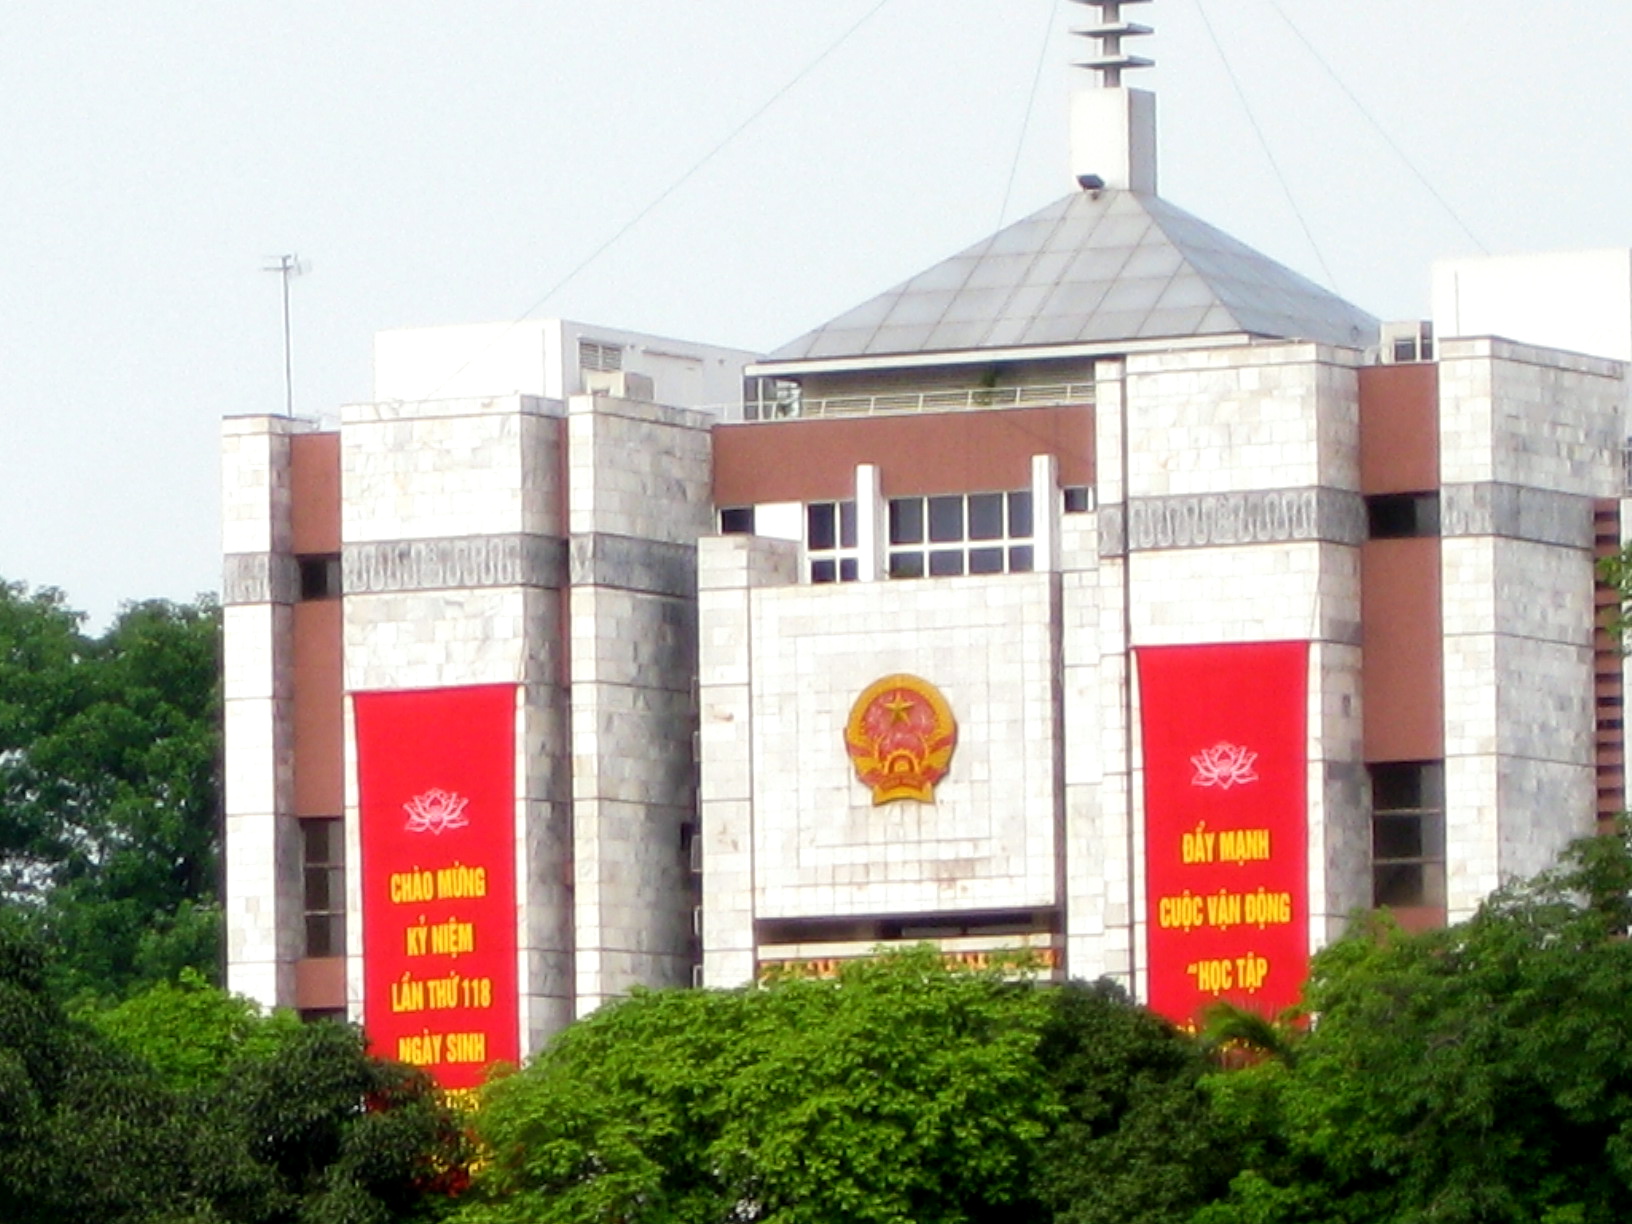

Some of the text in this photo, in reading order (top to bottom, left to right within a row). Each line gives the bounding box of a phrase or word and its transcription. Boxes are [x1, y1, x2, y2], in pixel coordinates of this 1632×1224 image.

[1219, 829, 1270, 866] MẠNH
[391, 865, 434, 904] CHÀO
[1159, 886, 1291, 933] CUỘC VẬN ĐỘNG
[431, 916, 474, 959] NIỆM
[1235, 951, 1268, 994] TẬP
[462, 978, 491, 1009] 118
[398, 1028, 485, 1066] NGÀY SINH
